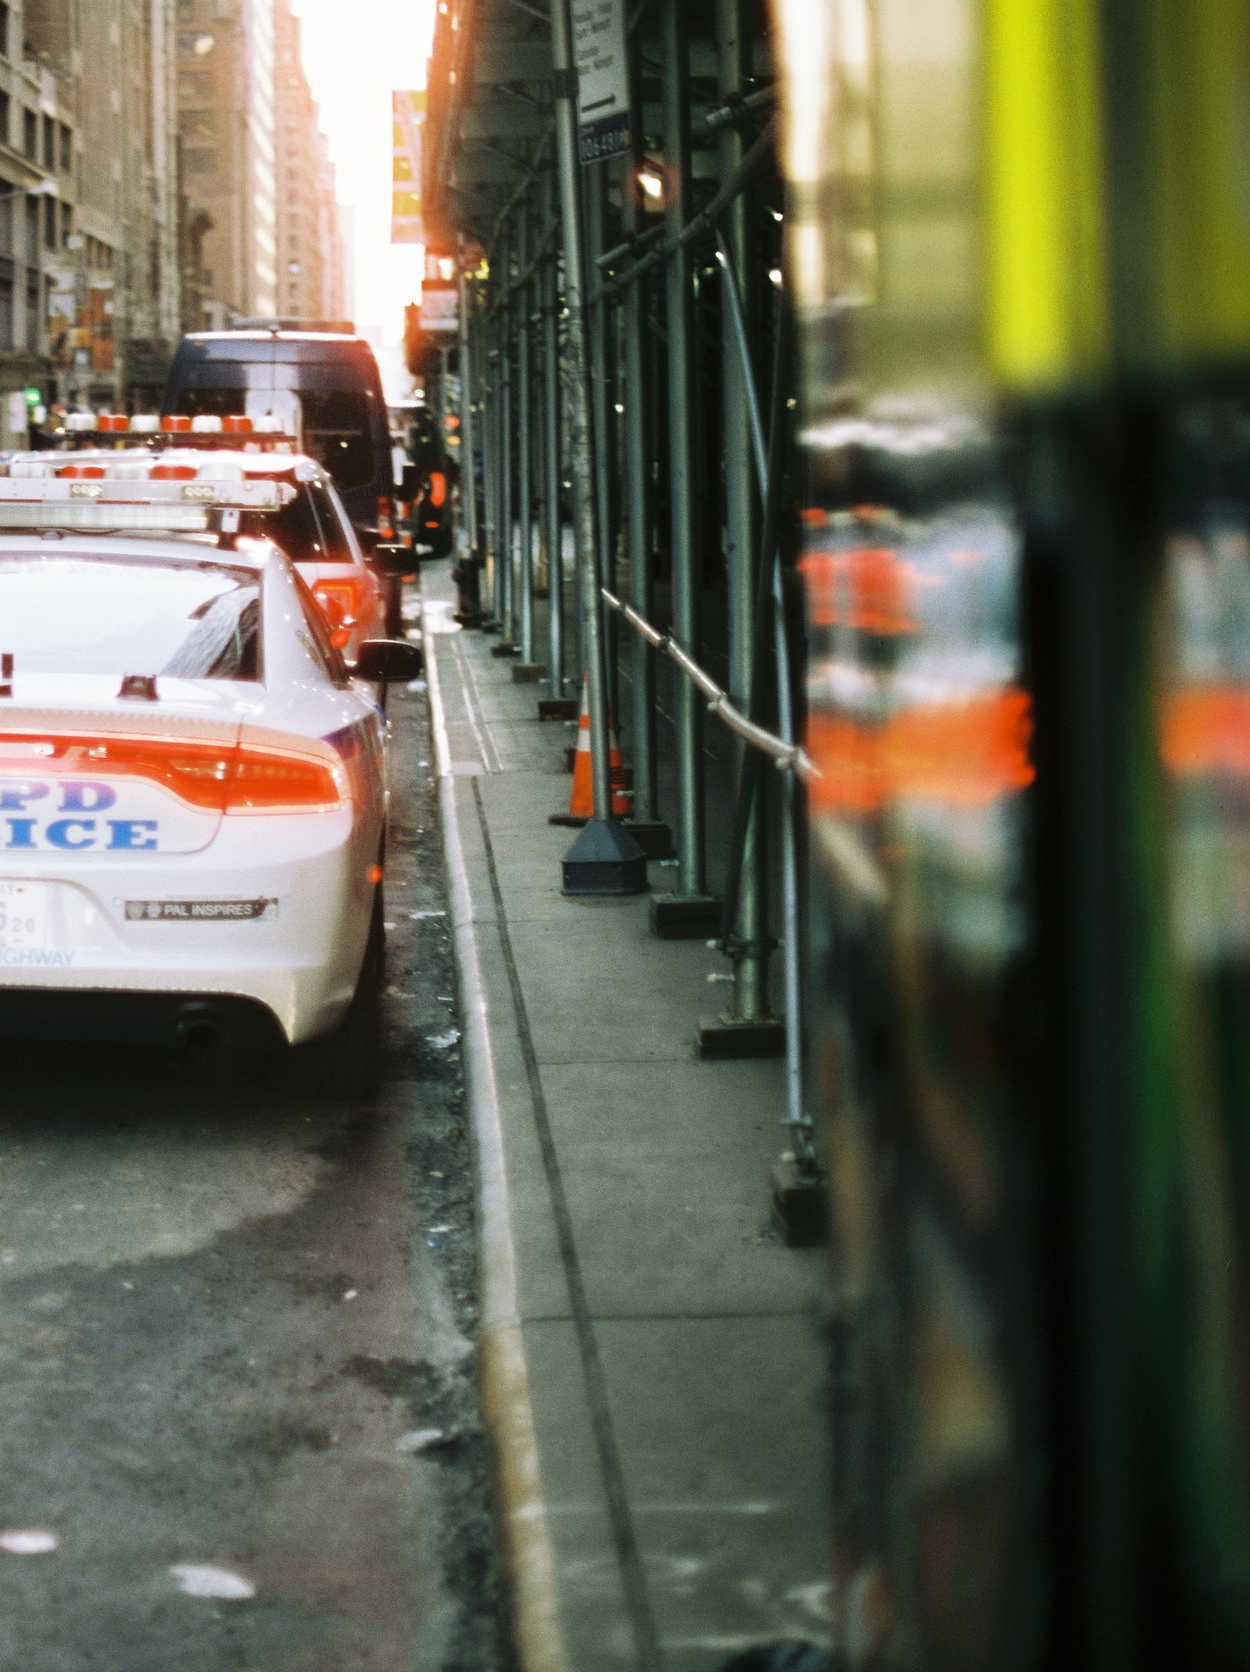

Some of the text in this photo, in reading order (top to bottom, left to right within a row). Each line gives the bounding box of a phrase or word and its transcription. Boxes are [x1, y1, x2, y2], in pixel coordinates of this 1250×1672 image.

[164, 903, 253, 916] PAL INSPIRES
[11, 917, 36, 933] 20
